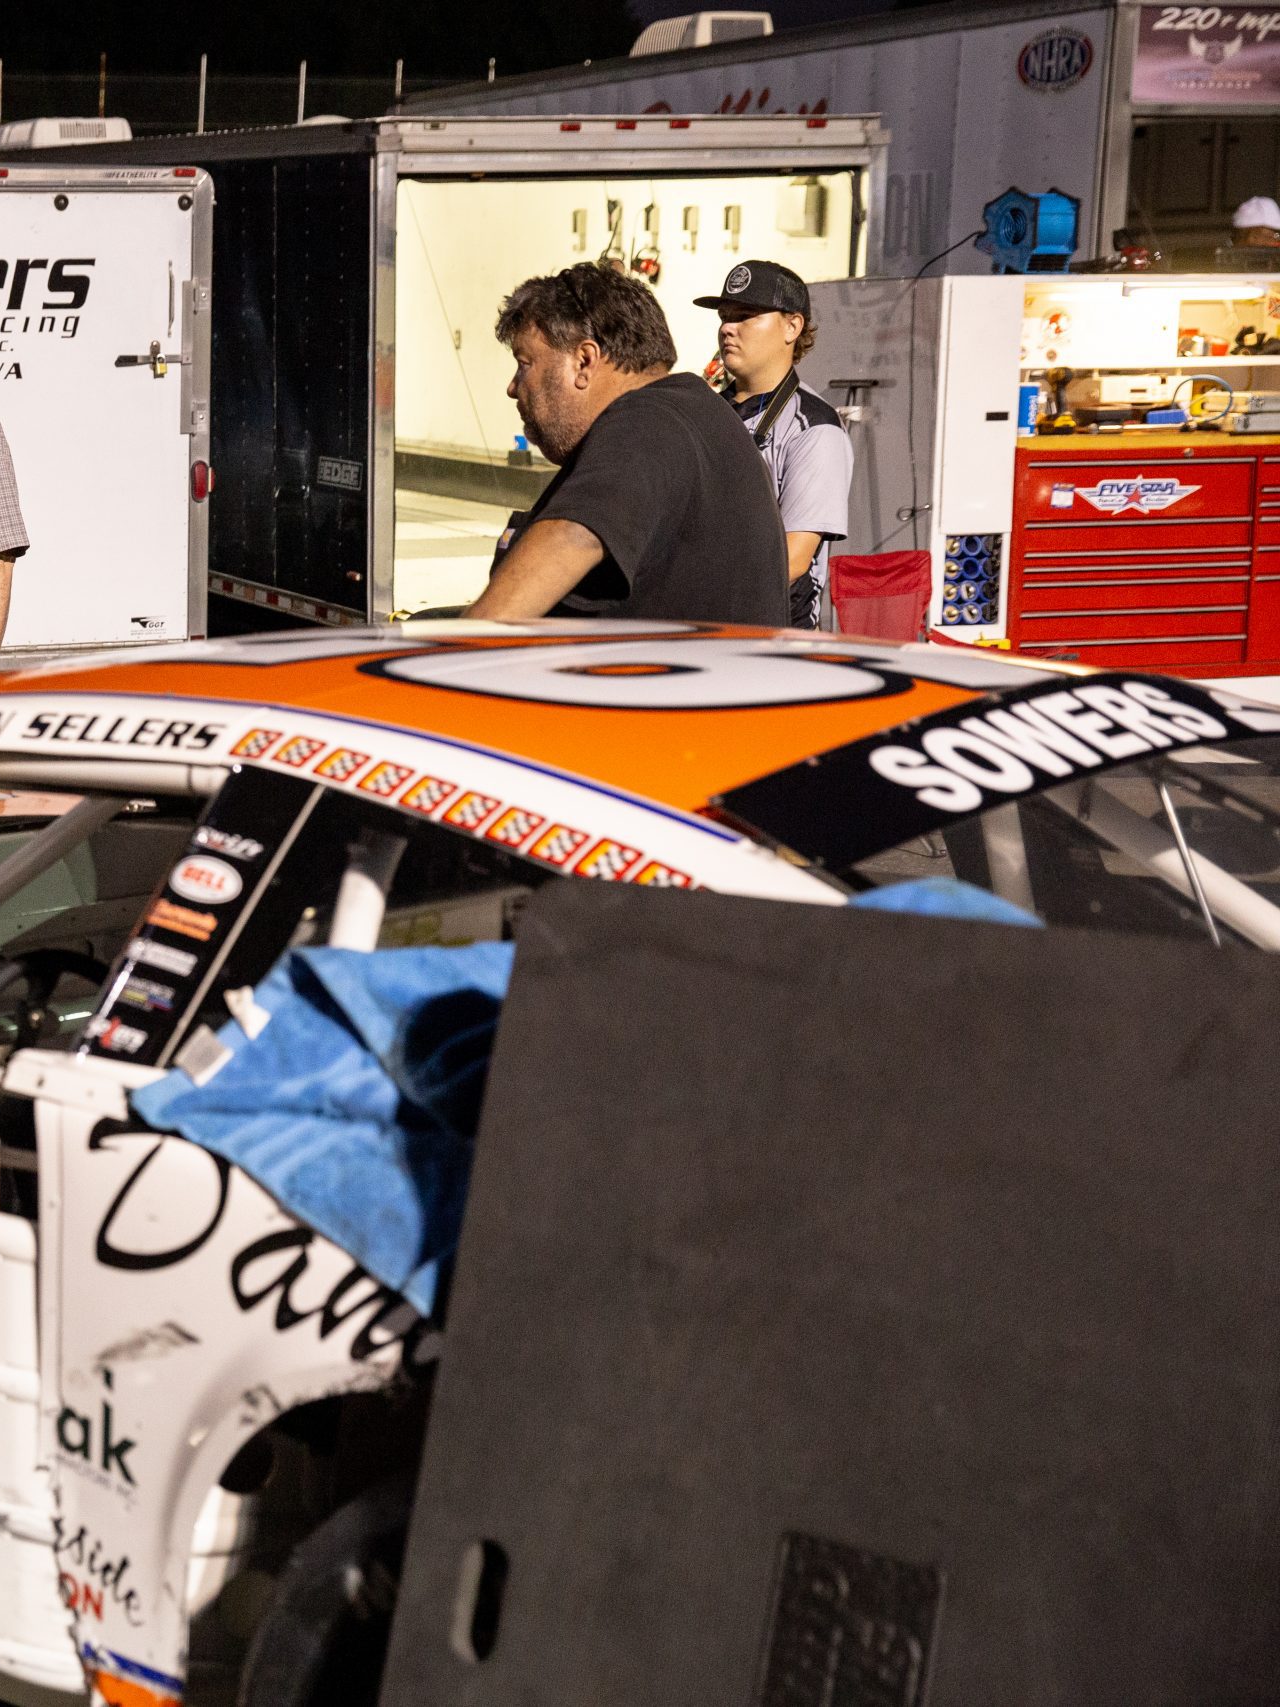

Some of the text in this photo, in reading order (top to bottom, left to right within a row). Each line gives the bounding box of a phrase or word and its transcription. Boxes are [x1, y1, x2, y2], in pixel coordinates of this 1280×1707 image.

[1027, 37, 1082, 80] NHRA
[320, 461, 360, 486] EDGE
[1098, 483, 1176, 497] FIVE STAR
[21, 712, 228, 750] SELLERS
[868, 680, 1228, 813] SOWERS
